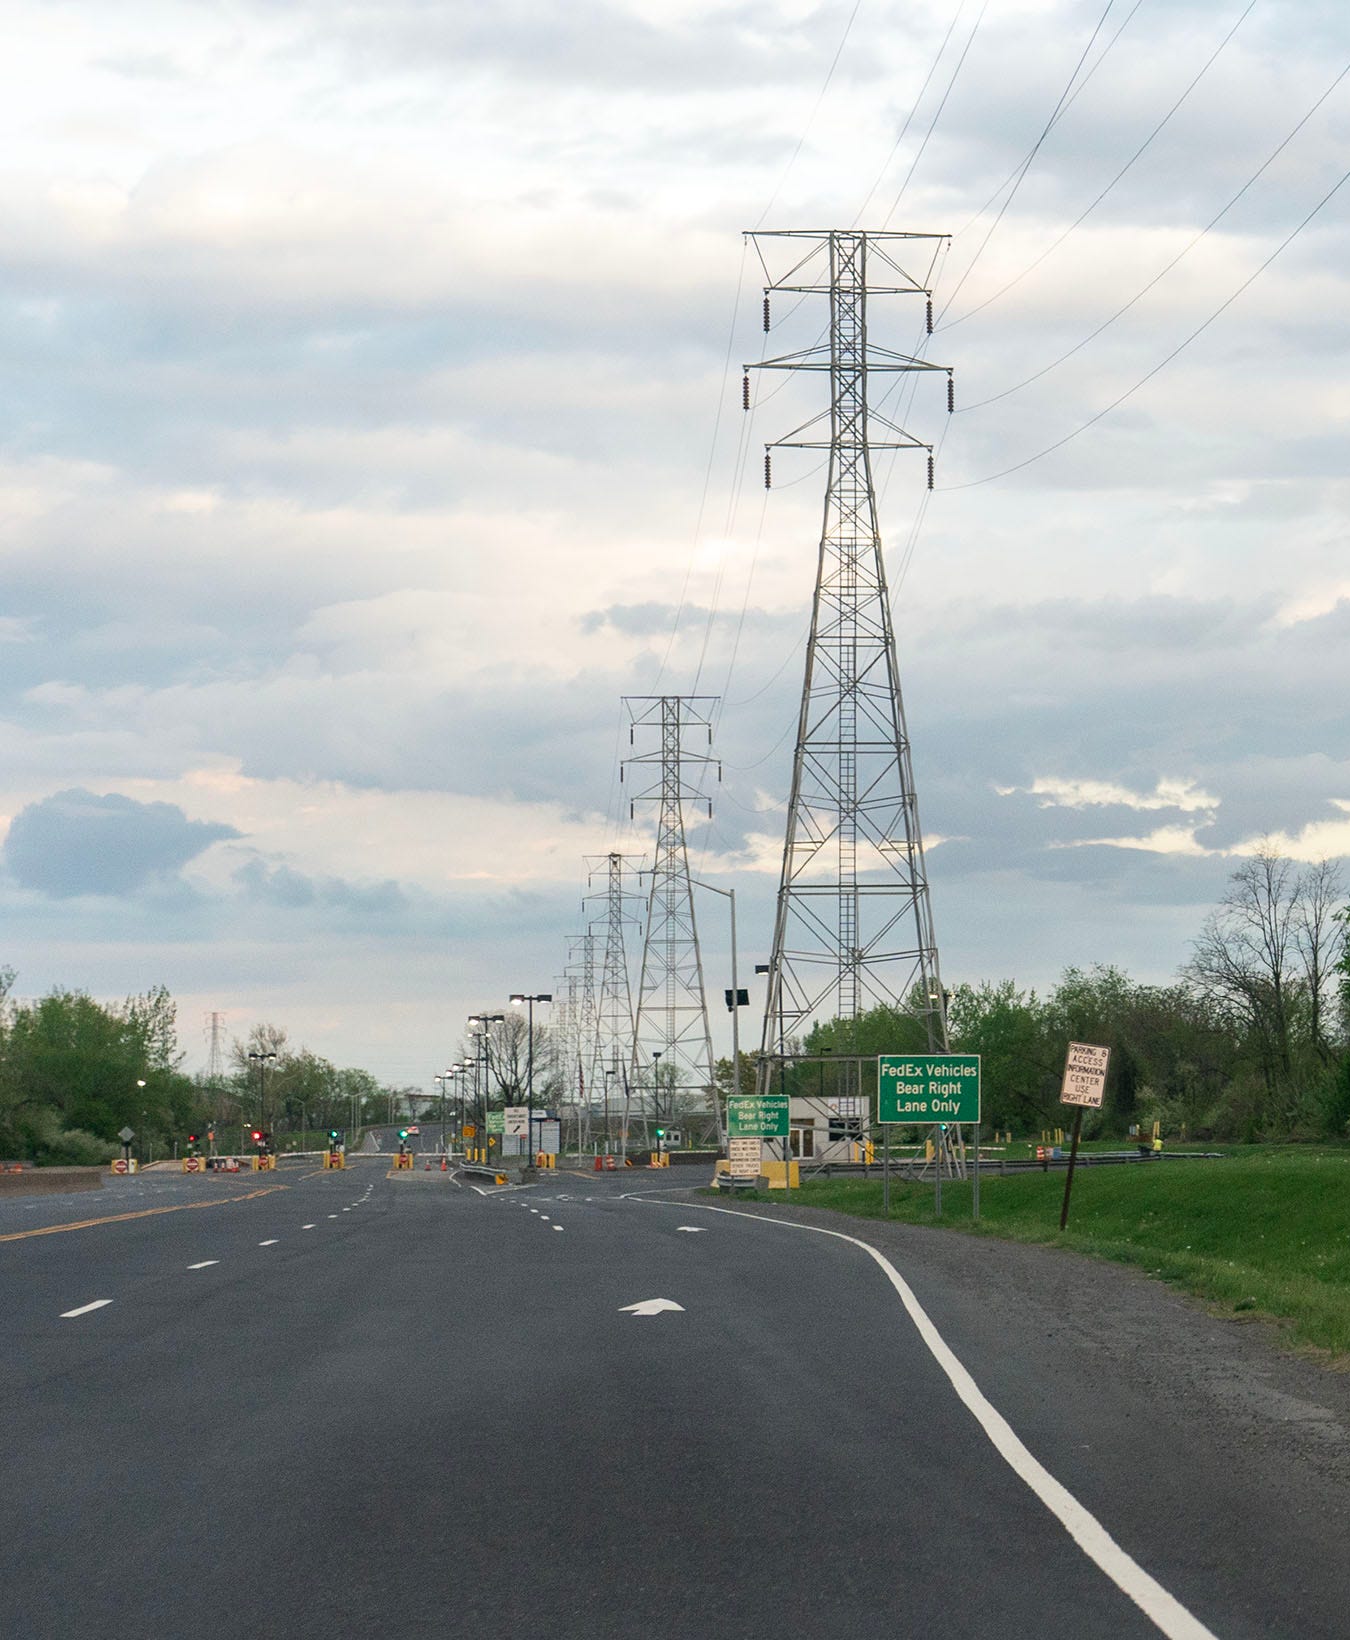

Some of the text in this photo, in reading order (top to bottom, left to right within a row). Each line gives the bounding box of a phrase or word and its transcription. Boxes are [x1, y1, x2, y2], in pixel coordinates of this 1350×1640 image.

[1071, 1046, 1097, 1056] PARKING
[1073, 1055, 1103, 1066] ACCESS
[881, 1064, 977, 1077] FedEx Vehicles
[1068, 1064, 1104, 1076] INFORMATION
[1070, 1075, 1100, 1085] CENTER
[896, 1082, 962, 1098] Bear Right
[1075, 1085, 1090, 1094] USE
[729, 1100, 788, 1109] FedEx Vehicles
[1063, 1093, 1100, 1105] RIGHT LANE
[897, 1100, 960, 1115] Lane Only
[738, 1111, 779, 1122] Bear Right
[760, 1122, 778, 1132] Only
